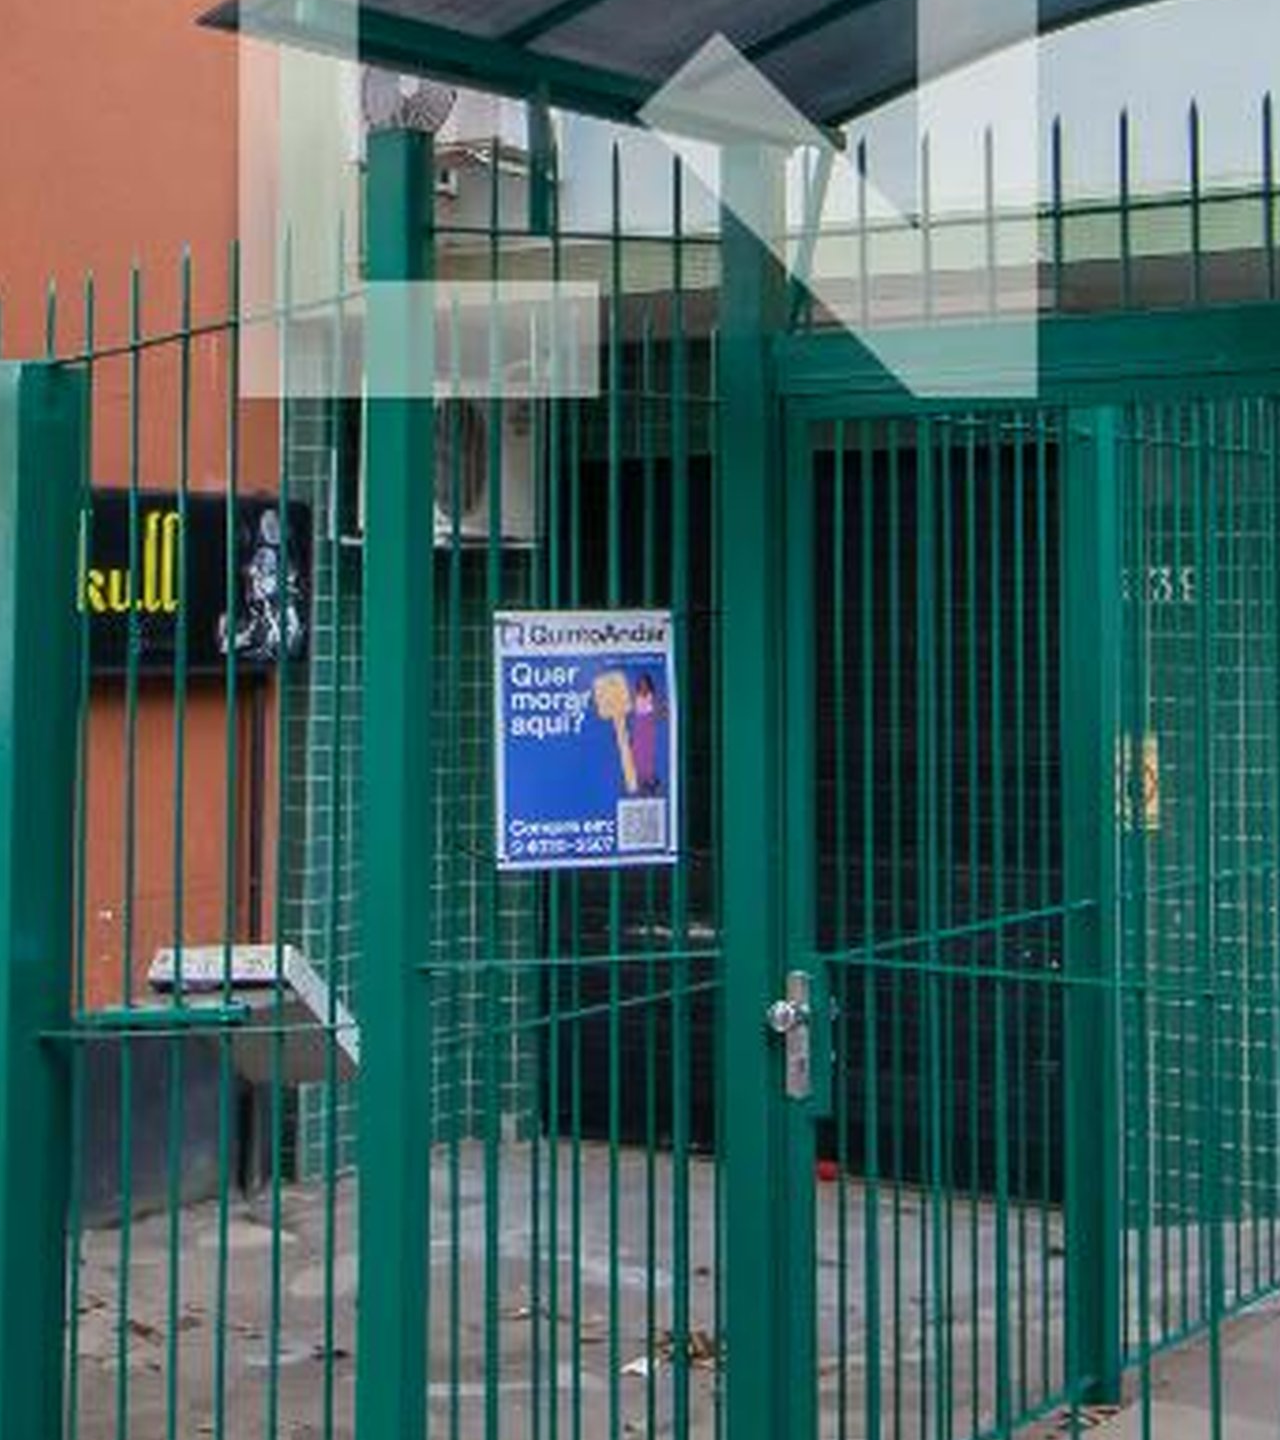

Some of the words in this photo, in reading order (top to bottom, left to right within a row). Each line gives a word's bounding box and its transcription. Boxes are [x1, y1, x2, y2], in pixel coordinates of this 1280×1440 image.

[511, 663, 580, 687] Quer
[511, 691, 592, 710] morar
[511, 712, 585, 738] aqui?
